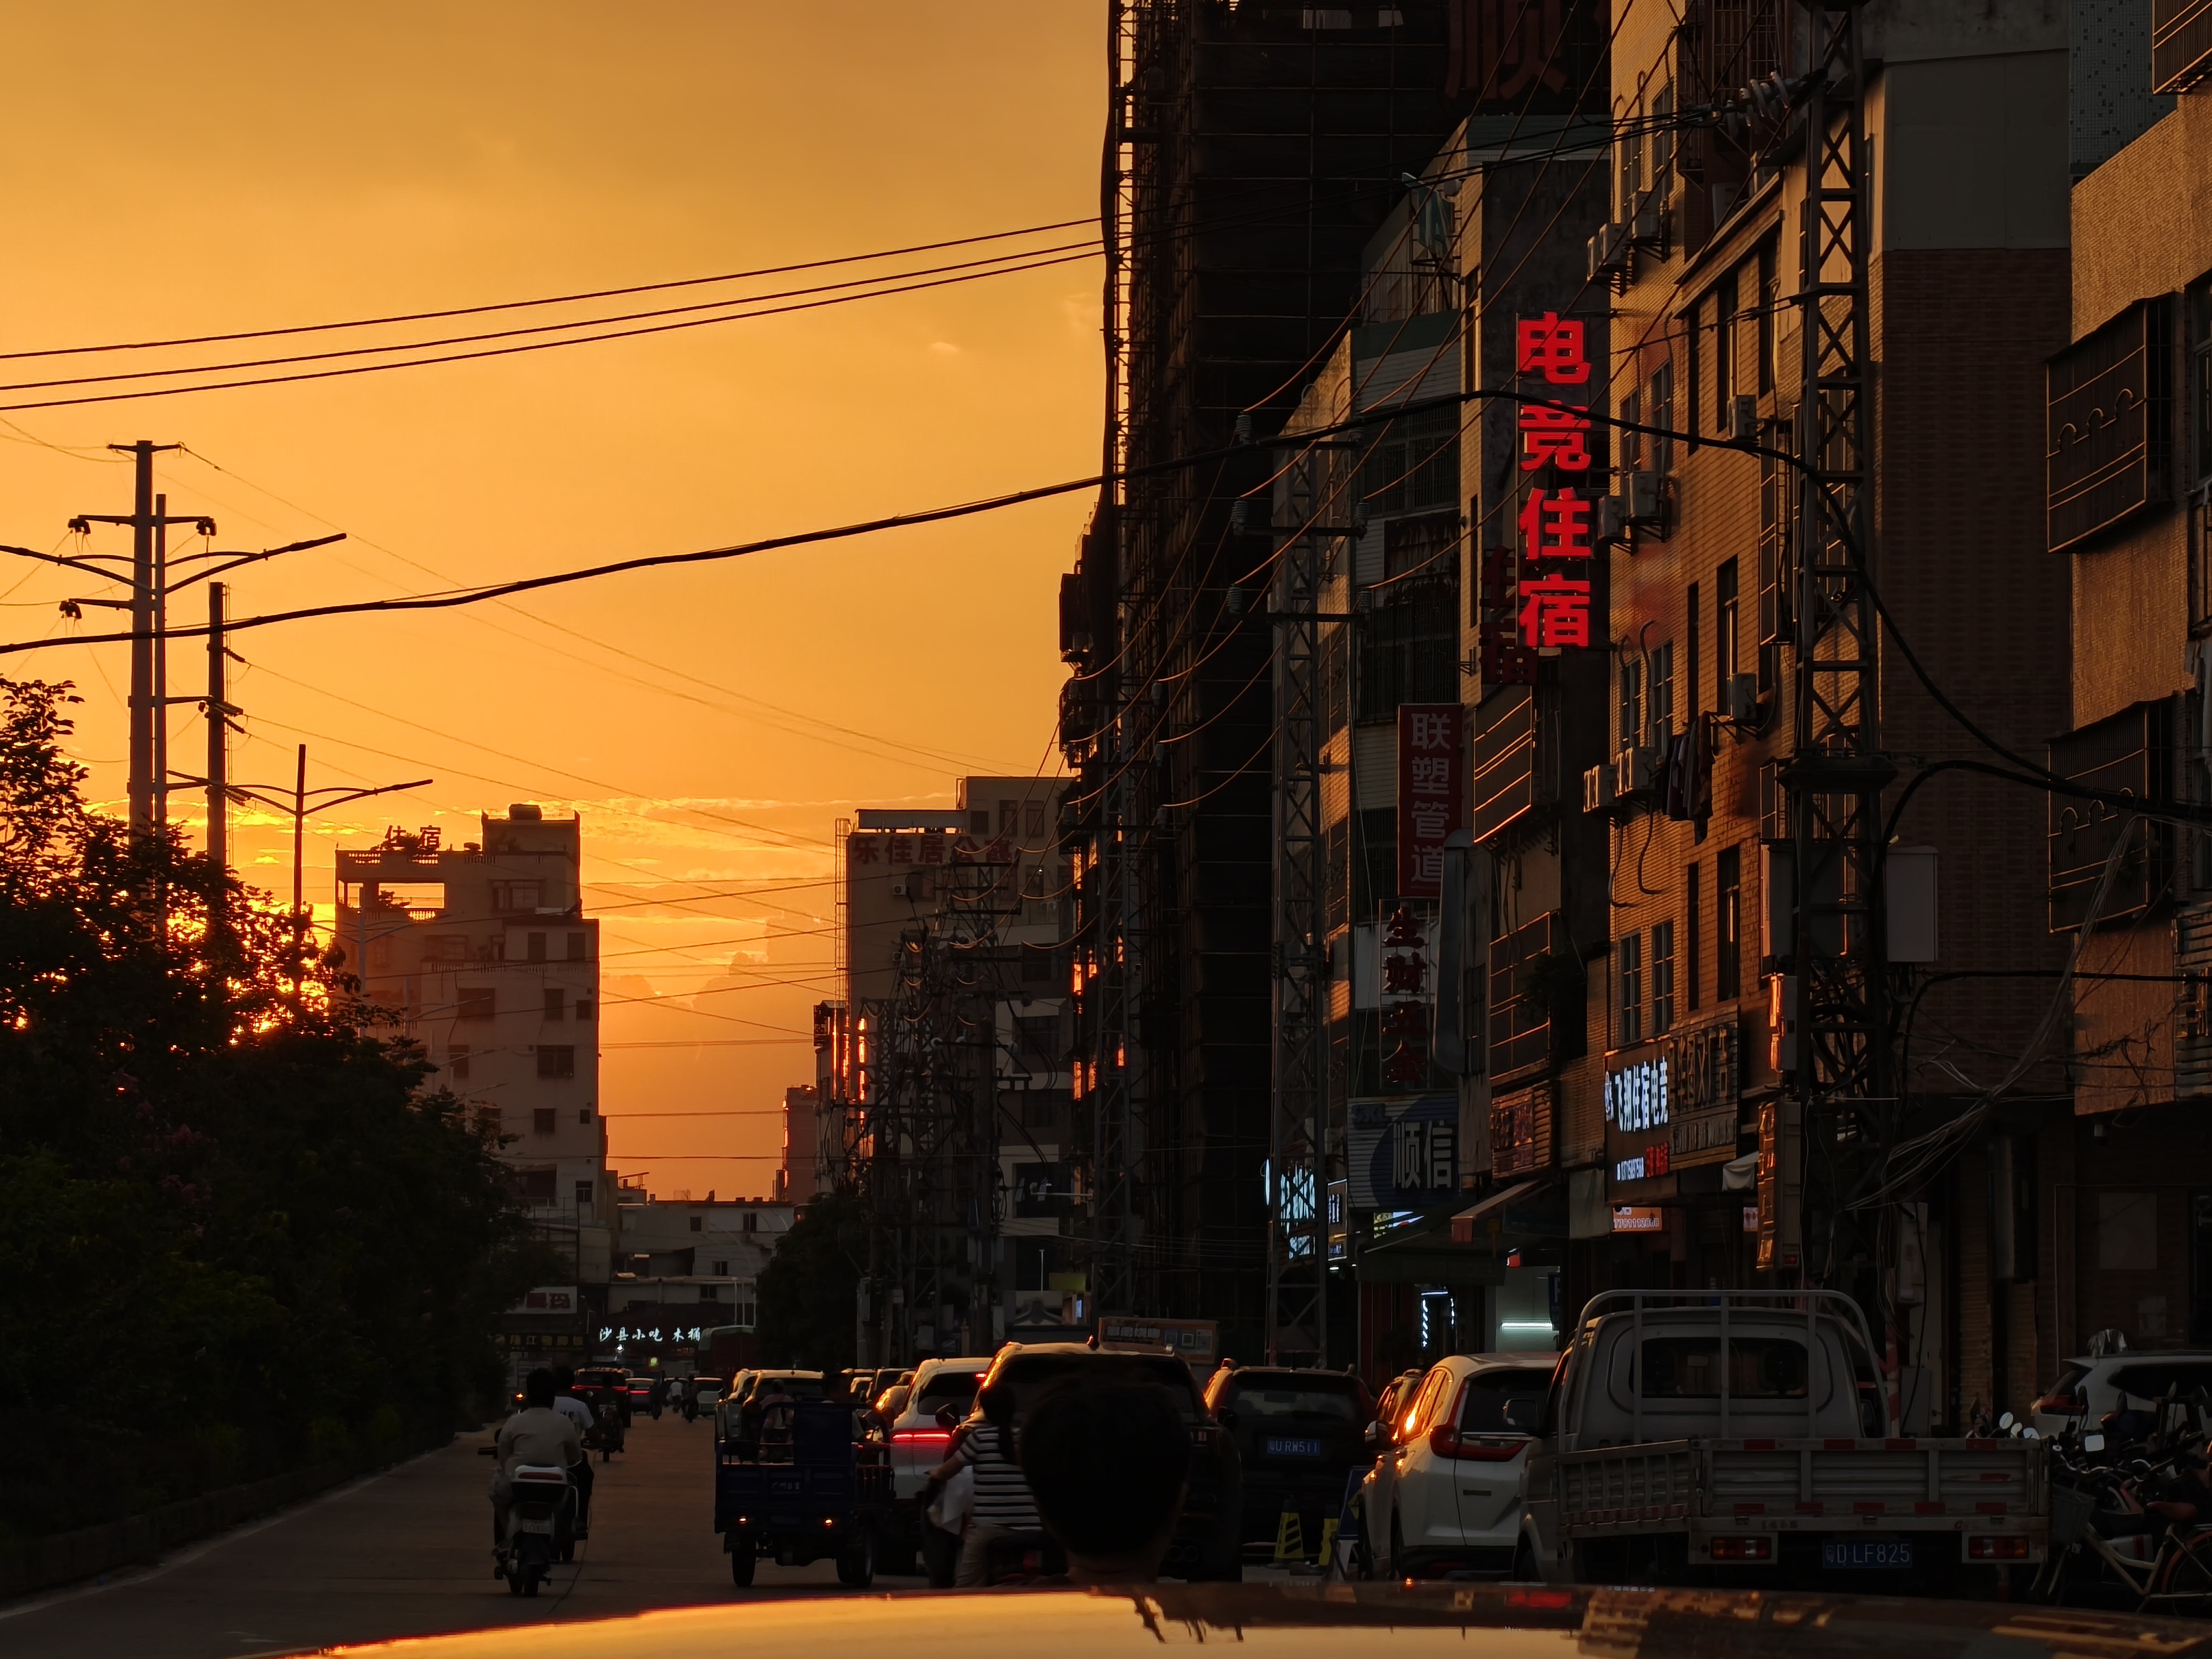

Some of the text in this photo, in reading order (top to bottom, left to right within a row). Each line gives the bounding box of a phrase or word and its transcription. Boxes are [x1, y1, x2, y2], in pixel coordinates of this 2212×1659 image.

[1518, 312, 1591, 649] 电竞住宿
[1411, 712, 1452, 884] 联塑管道
[1392, 1119, 1453, 1189] 顺信
[599, 1326, 663, 1342] 沙县小吃
